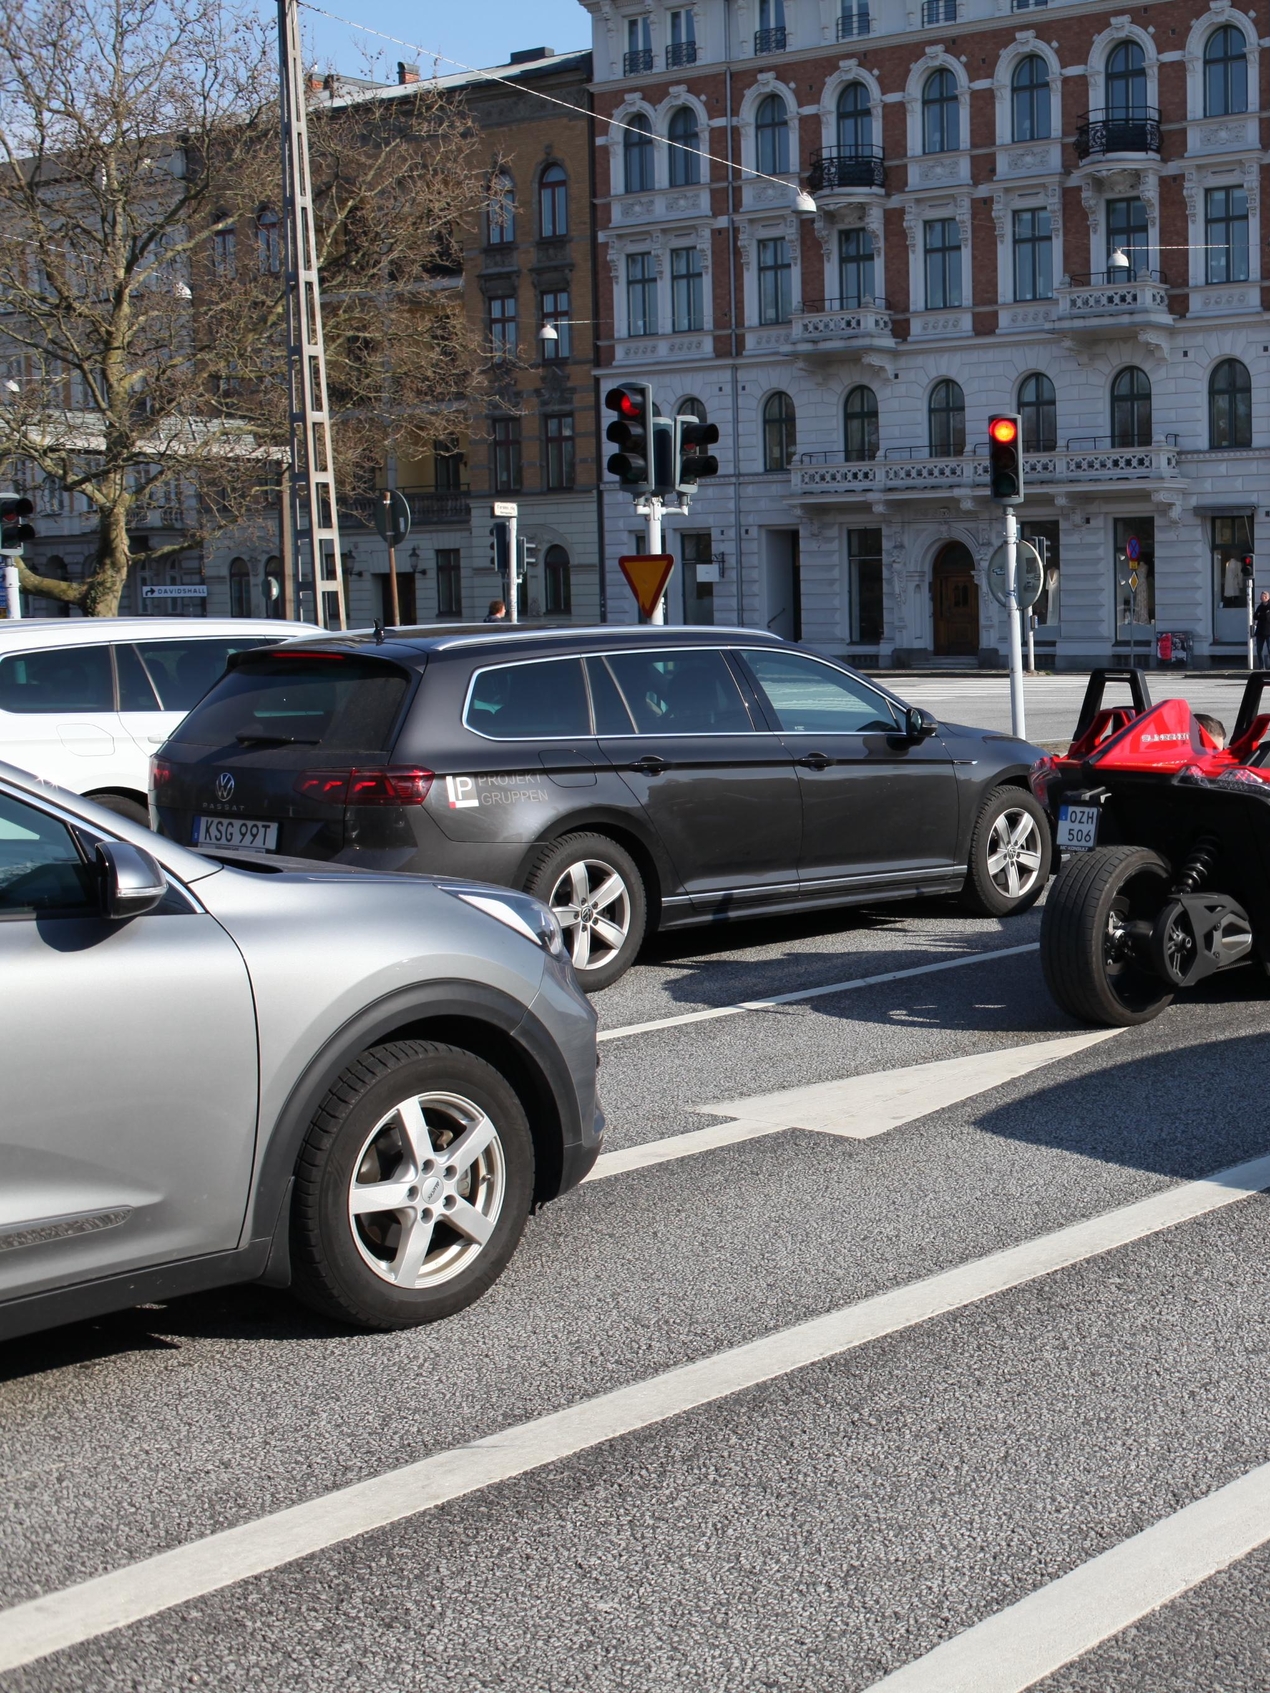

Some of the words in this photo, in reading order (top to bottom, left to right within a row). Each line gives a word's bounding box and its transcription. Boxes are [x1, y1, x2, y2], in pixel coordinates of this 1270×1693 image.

[478, 772, 541, 786] PROJEKT
[481, 789, 549, 805] GRUPPEN
[203, 802, 245, 811] PASSAT
[1070, 810, 1094, 824] OZH
[204, 819, 234, 843] KSG
[239, 822, 271, 846] 99T
[1067, 829, 1091, 842] 506
